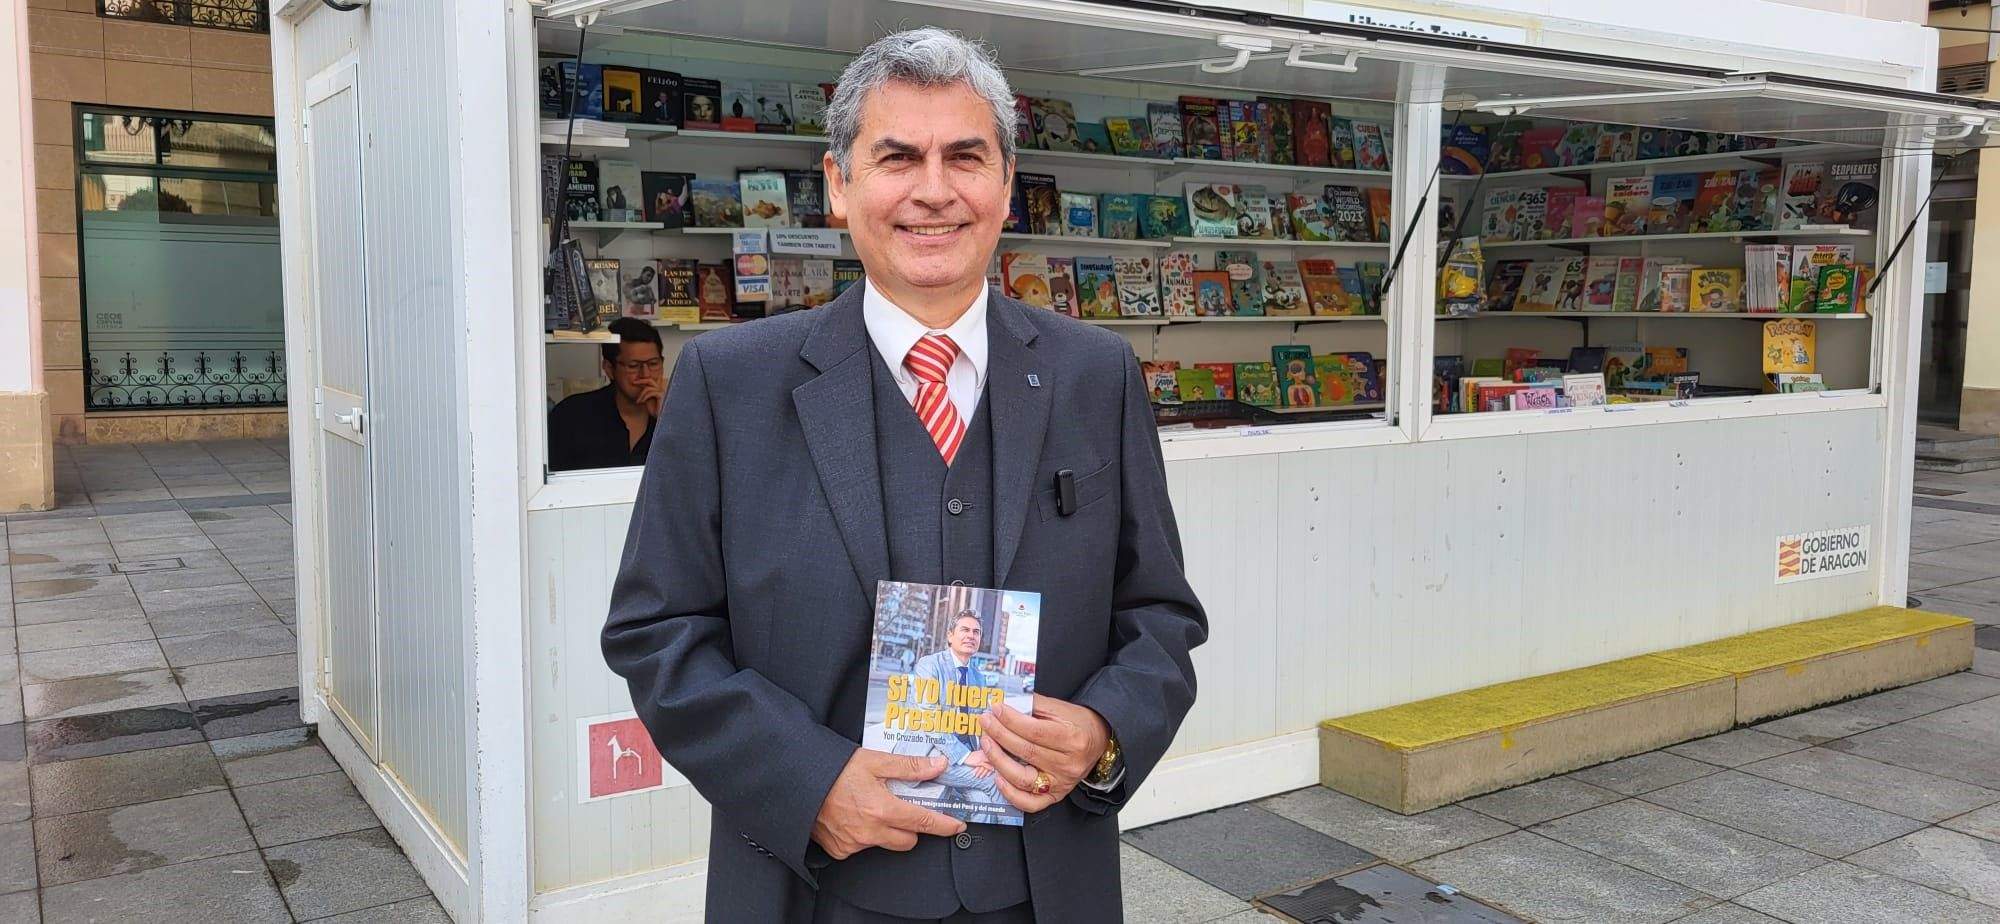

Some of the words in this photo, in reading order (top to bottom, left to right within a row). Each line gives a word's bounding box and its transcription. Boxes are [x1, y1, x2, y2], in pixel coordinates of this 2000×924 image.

[1831, 163, 1878, 176] SERPIENTES
[567, 183, 595, 192] AMIENTO
[1526, 192, 1546, 205] 365
[1338, 211, 1363, 222] 2023
[1123, 262, 1143, 274] 365
[1567, 261, 1581, 273] 65
[834, 271, 861, 281] ENIGM
[743, 284, 765, 293] VISA
[1802, 532, 1860, 554] GOBIERNO
[1801, 557, 1816, 575] DE
[914, 675, 940, 704] YO
[945, 679, 1005, 709] fuera
[884, 702, 982, 737] Presiden
[884, 731, 895, 741] Yon
[896, 732, 924, 743] Cruzado
[925, 735, 946, 745] Tirado
